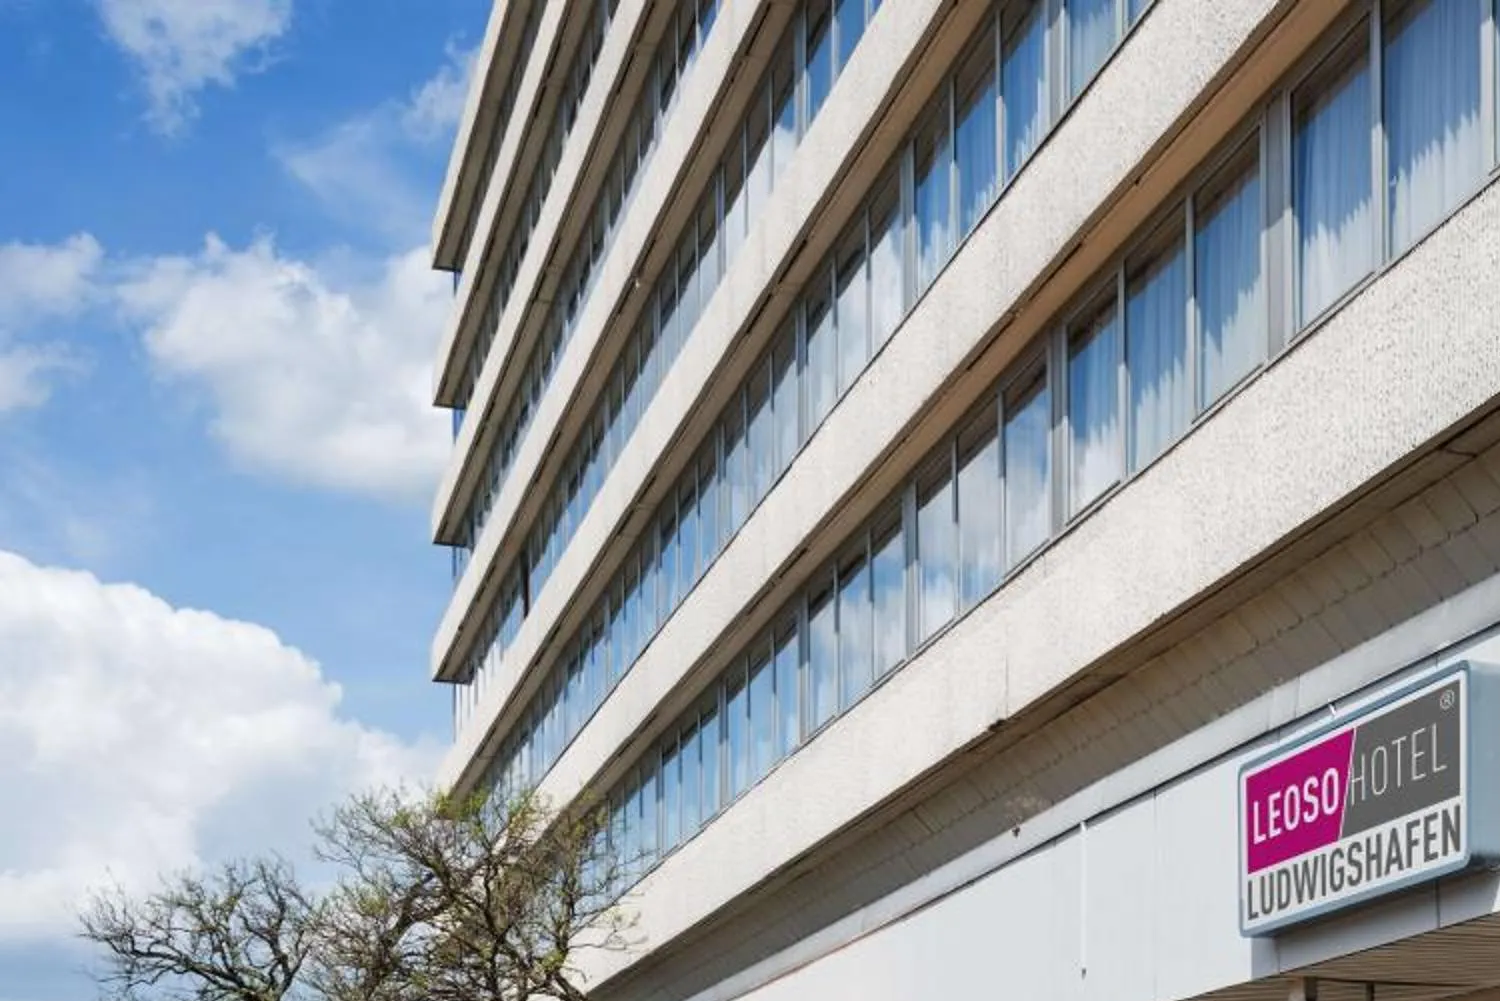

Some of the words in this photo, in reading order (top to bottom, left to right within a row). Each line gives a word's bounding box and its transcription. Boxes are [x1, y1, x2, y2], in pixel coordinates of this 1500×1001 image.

[1253, 767, 1340, 845] LEOSO
[1350, 723, 1448, 806] HOTEL
[1247, 804, 1462, 921] LUDWIGSHAFEN
